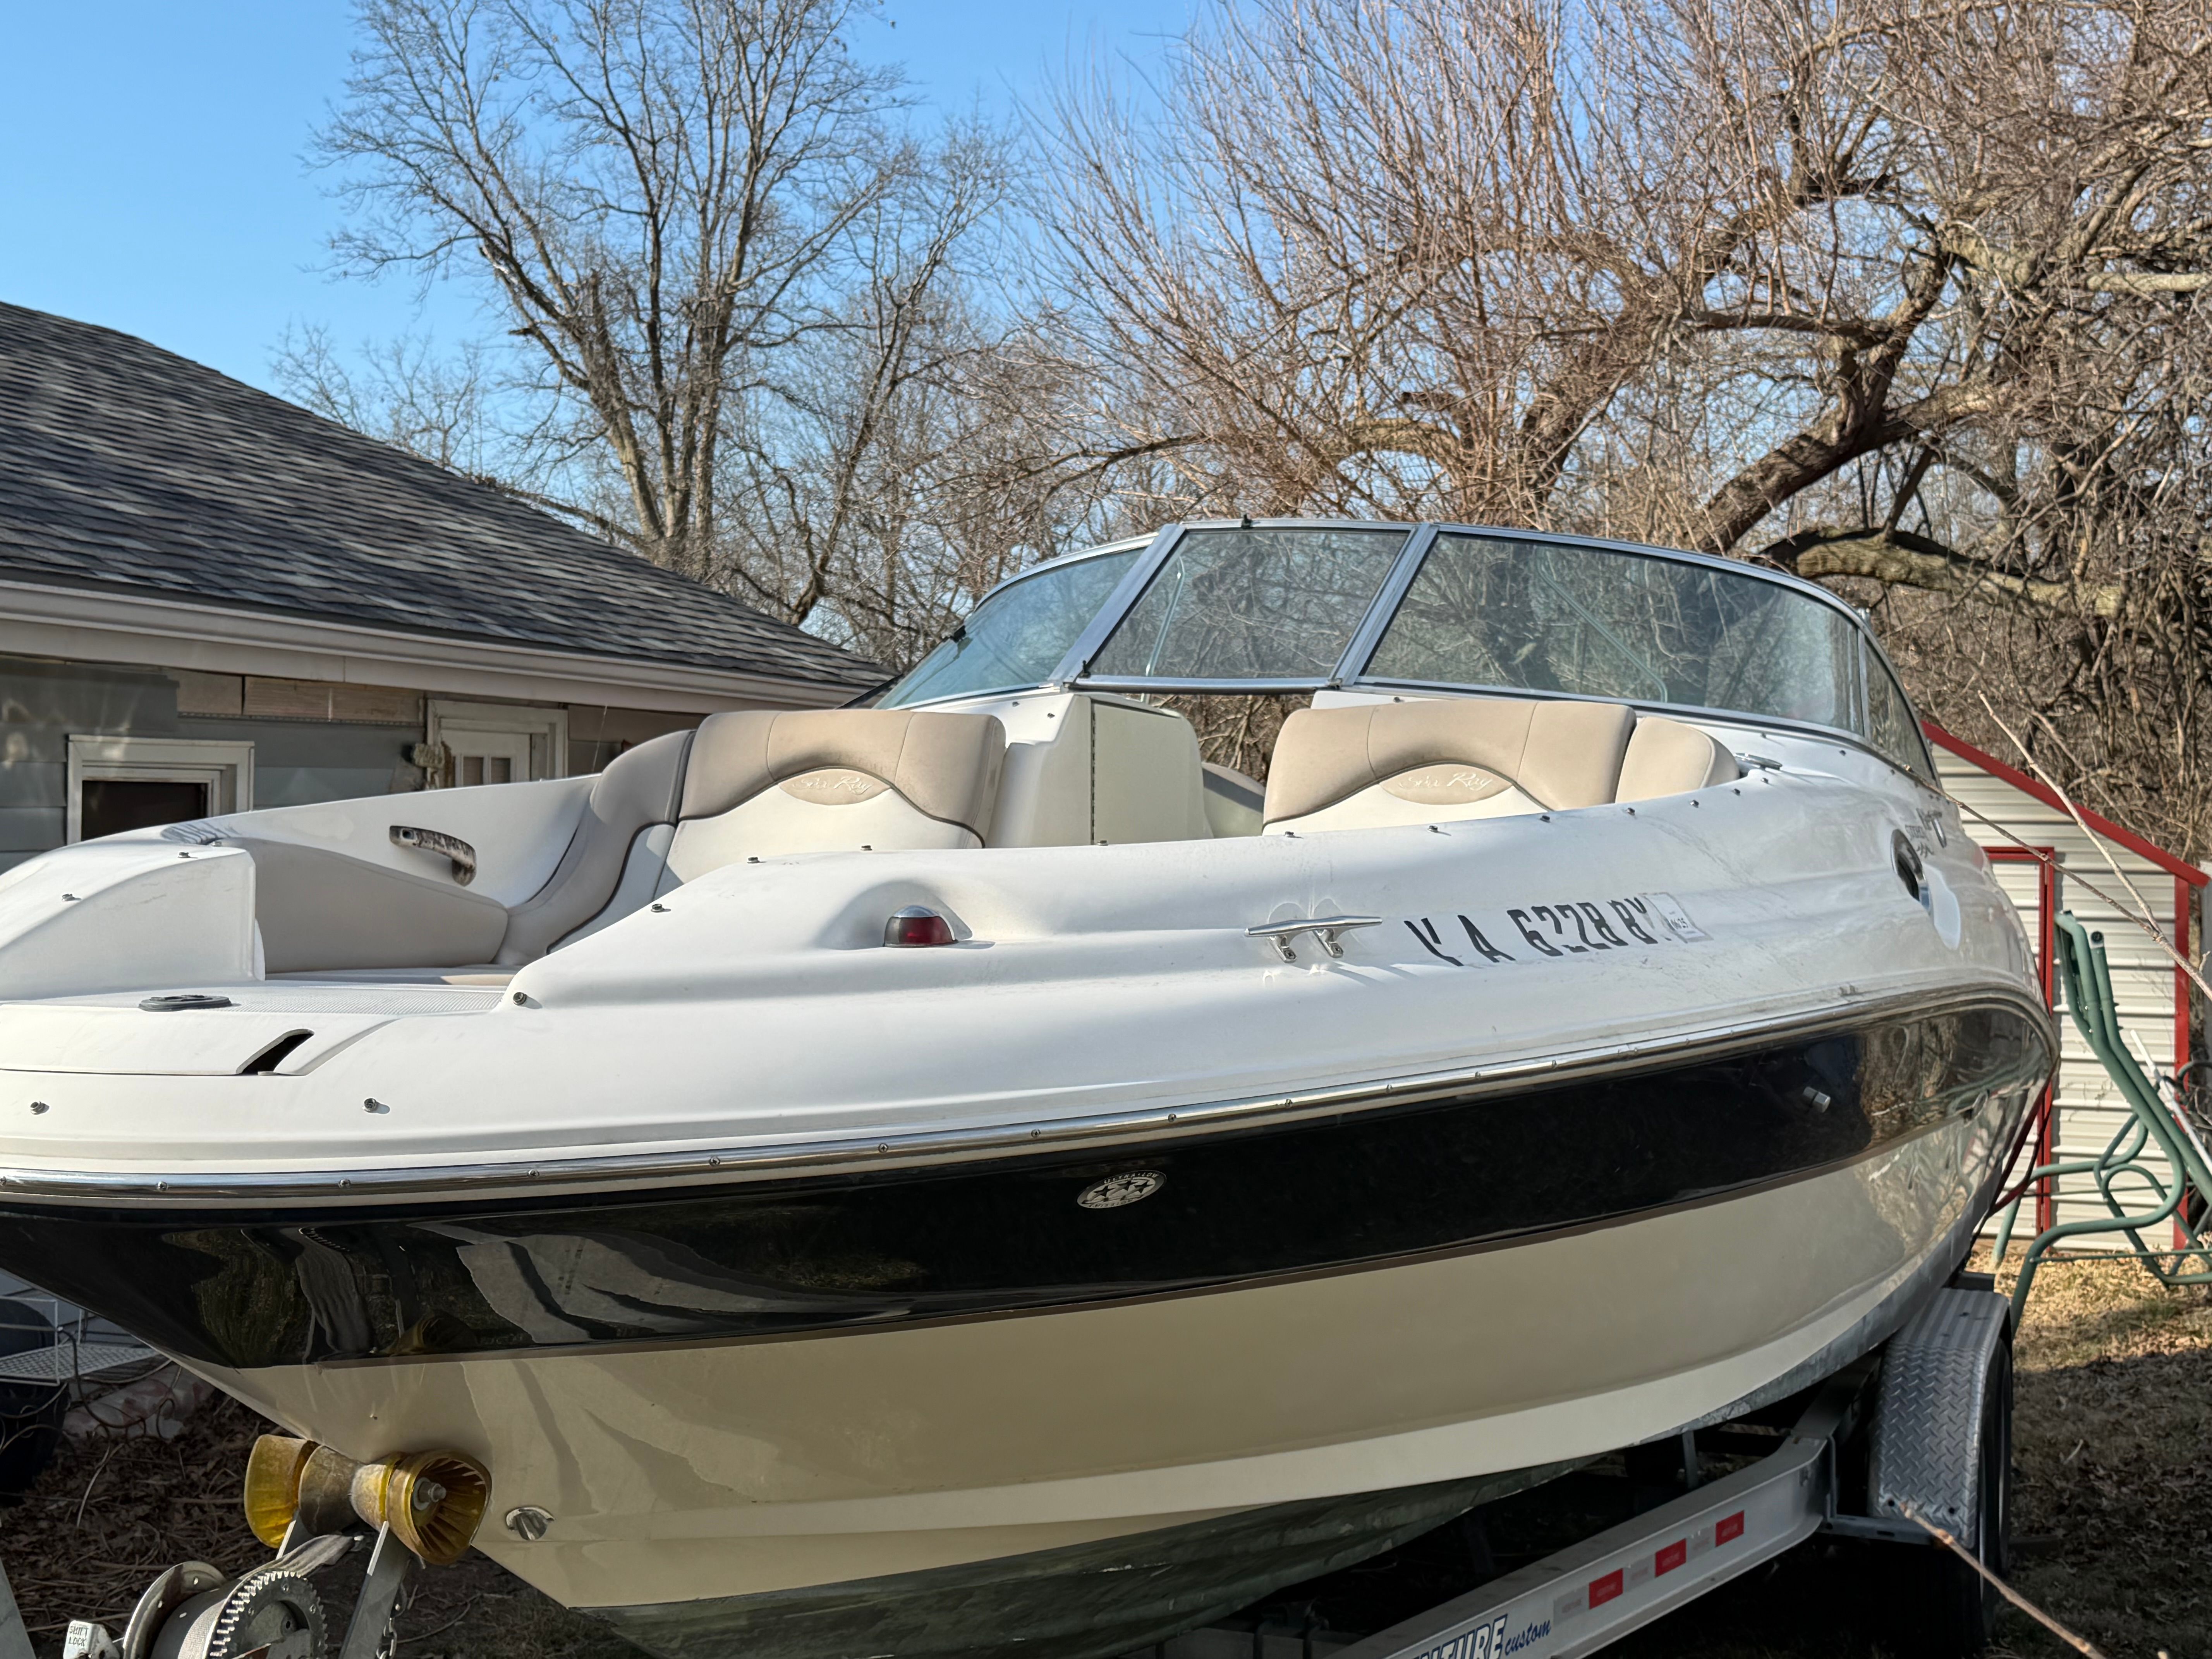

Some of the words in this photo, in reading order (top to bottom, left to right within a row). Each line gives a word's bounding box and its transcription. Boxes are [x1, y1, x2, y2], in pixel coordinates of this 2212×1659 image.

[833, 776, 872, 795] Ray
[1446, 773, 1493, 791] Ray
[1506, 902, 1629, 957] 6228
[68, 1636, 87, 1647] LOCK
[1504, 1620, 1551, 1656] custom
